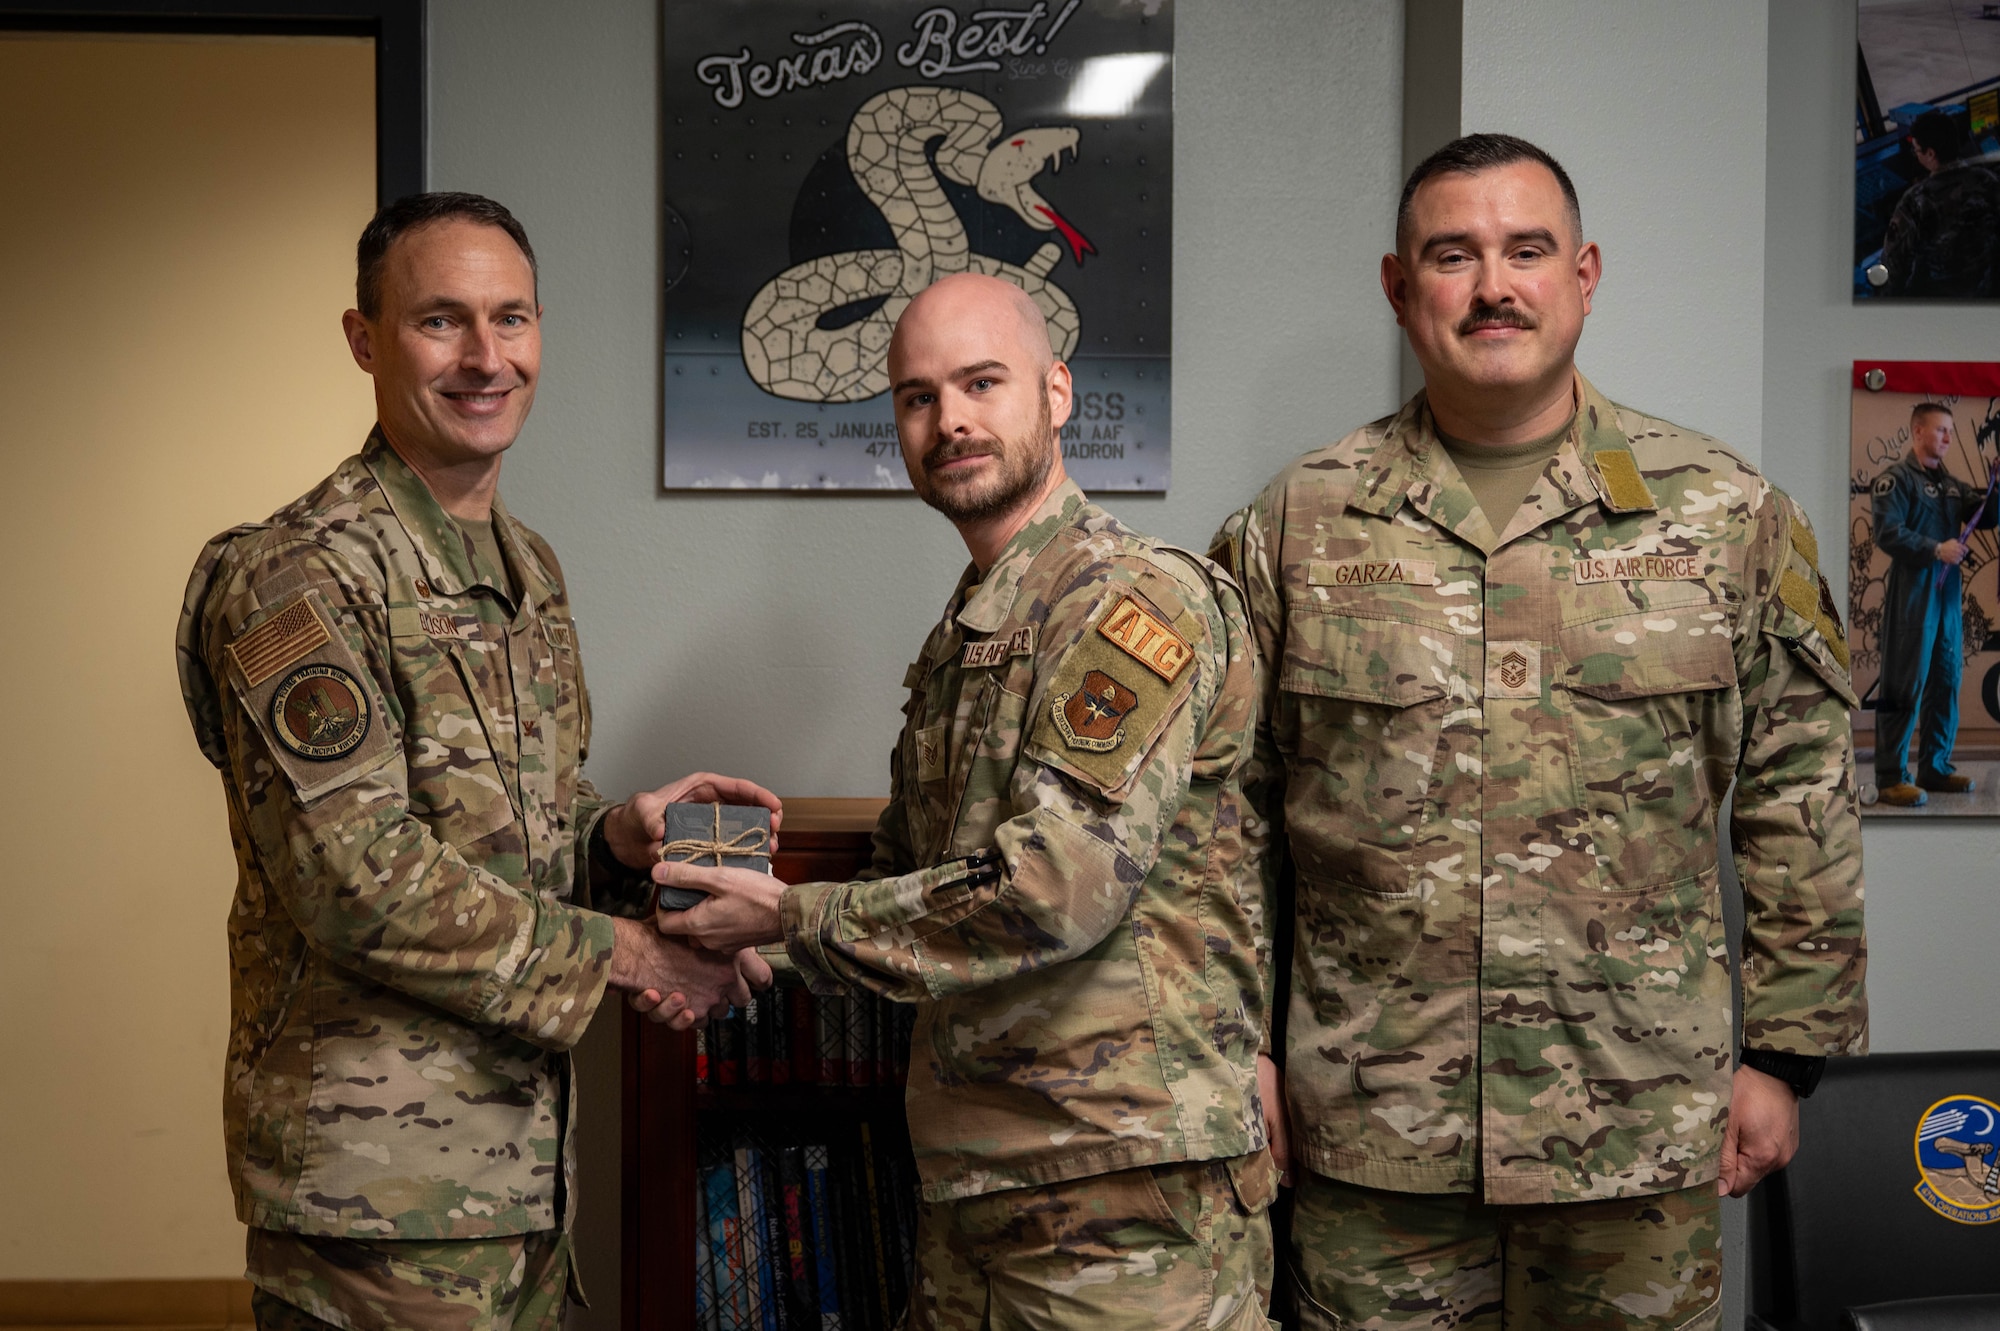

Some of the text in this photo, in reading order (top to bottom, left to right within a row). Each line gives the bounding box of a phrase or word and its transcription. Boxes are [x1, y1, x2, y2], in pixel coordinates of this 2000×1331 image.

[697, 0, 1080, 108] Texas Best!
[748, 421, 898, 439] EST. 25 JANUAR
[1092, 424, 1124, 440] AAF
[1335, 564, 1405, 585] GARZA
[1580, 556, 1699, 579] U.S. AIR FORCE
[1108, 608, 1183, 671] ATC
[296, 666, 329, 681] TRAINING
[330, 668, 348, 683] WING
[298, 743, 311, 754] HIC
[337, 733, 359, 751] VIRTUS
[1936, 1200, 1988, 1220] OPERATIONS
